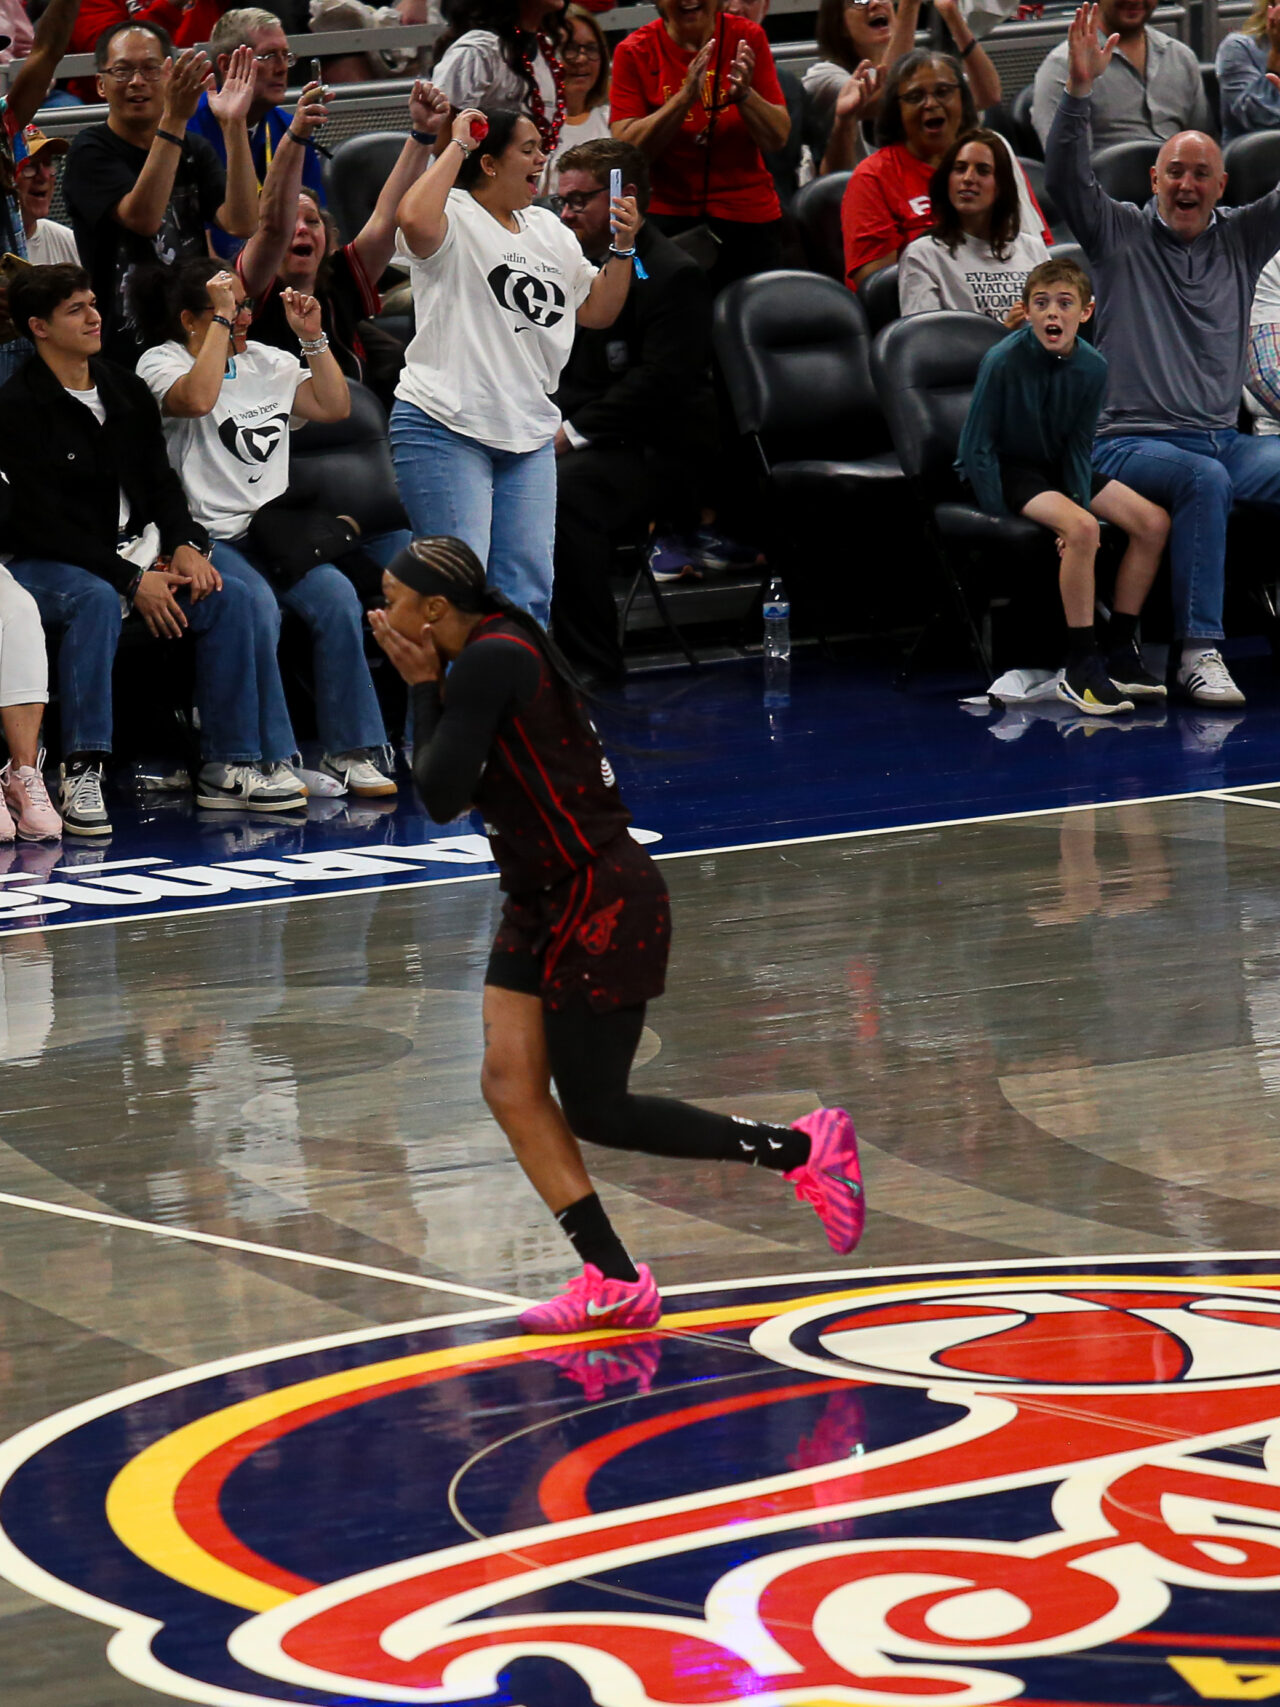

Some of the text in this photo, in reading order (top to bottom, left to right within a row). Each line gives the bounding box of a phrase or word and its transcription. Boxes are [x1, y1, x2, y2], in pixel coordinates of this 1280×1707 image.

[965, 271, 1029, 282] EVERYON
[971, 282, 1024, 294] WATCH
[975, 295, 1023, 308] WOME
[239, 408, 259, 420] was
